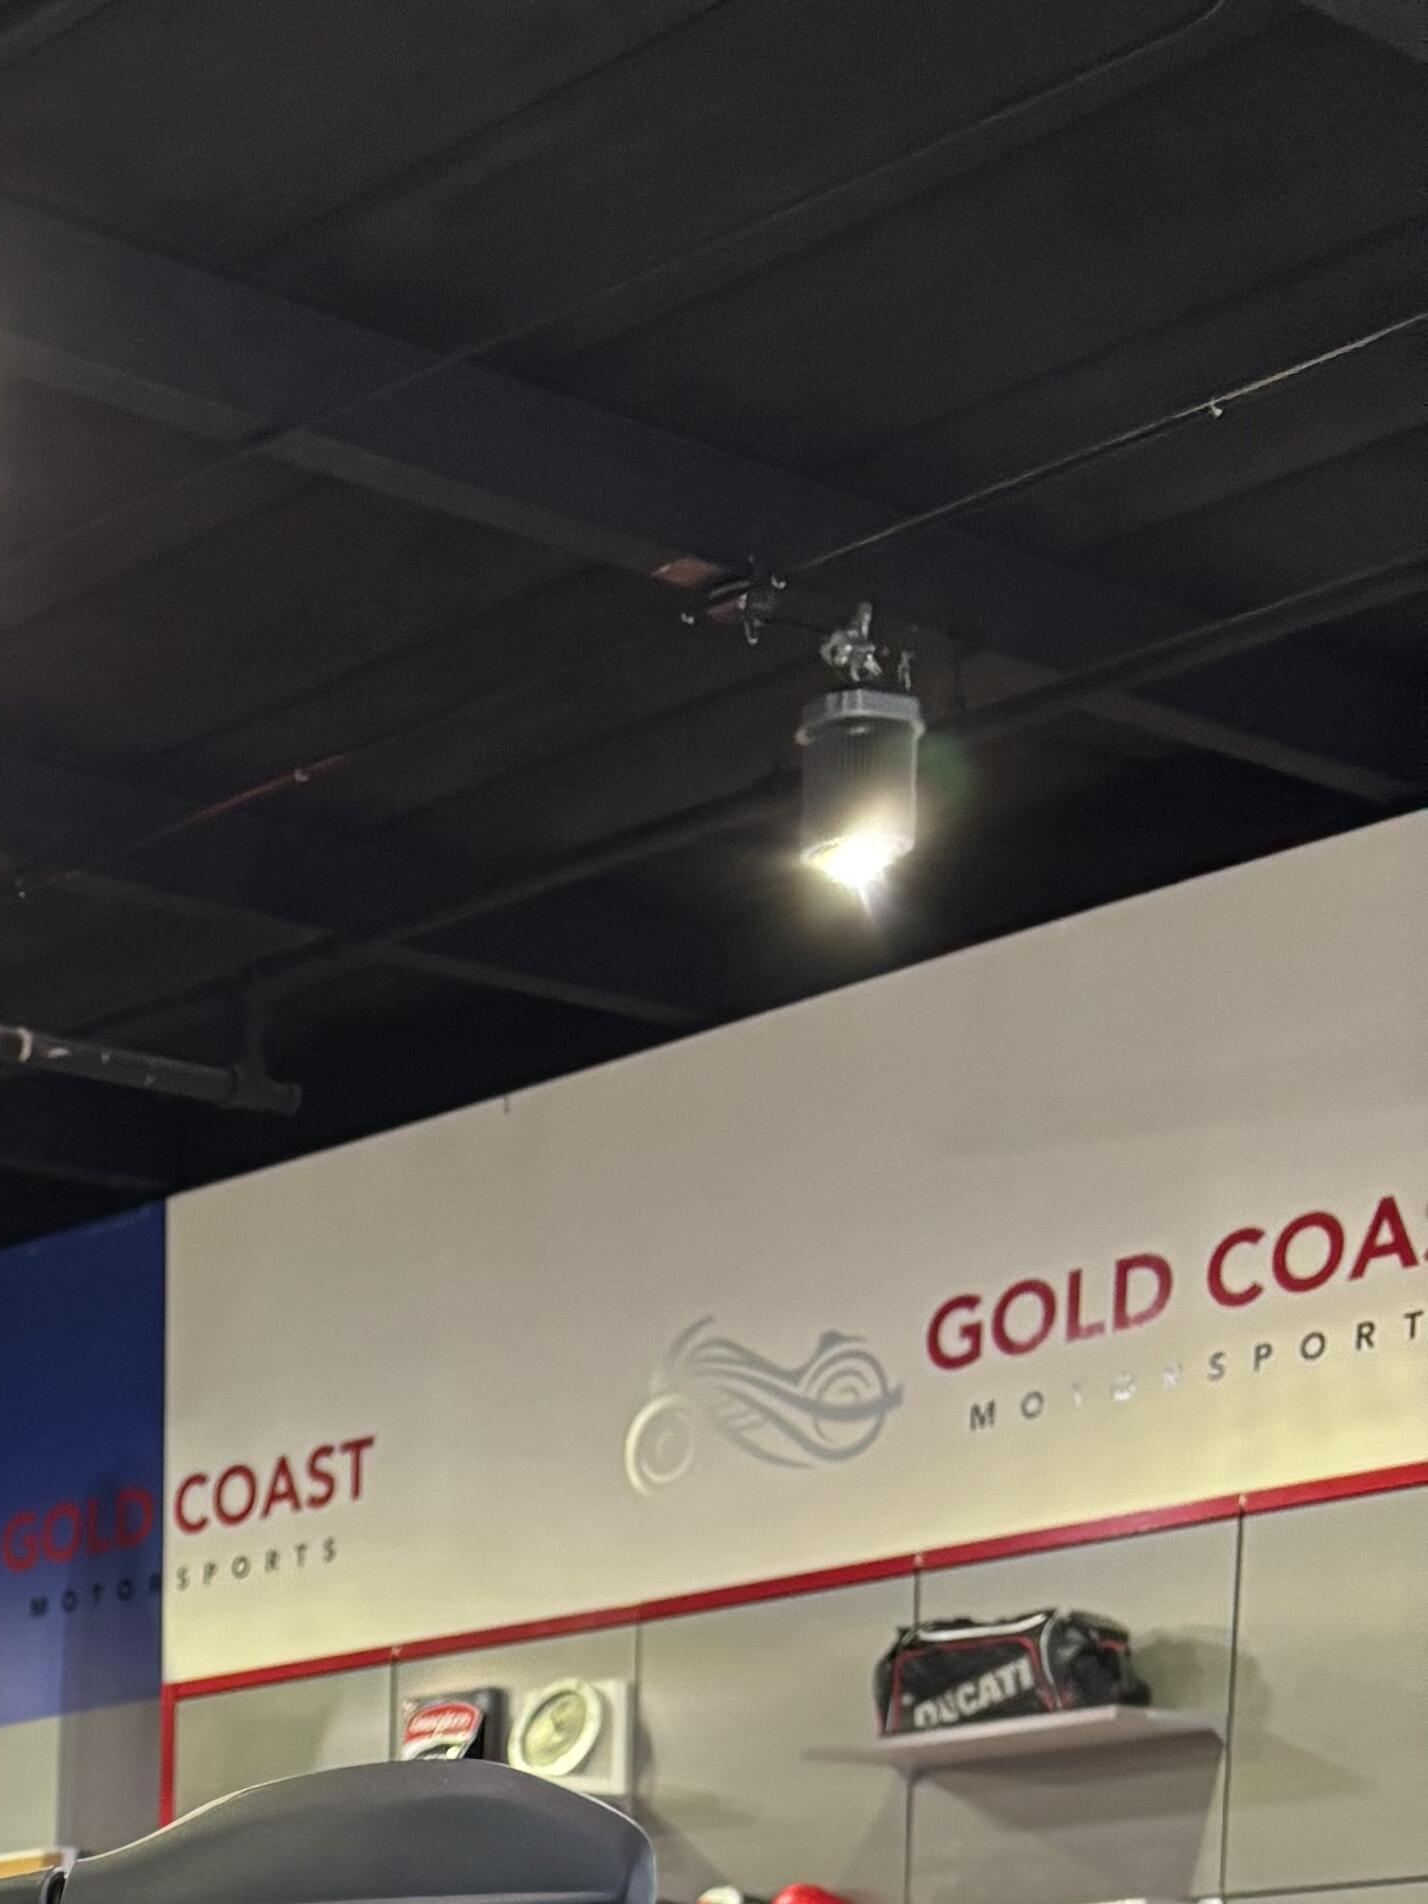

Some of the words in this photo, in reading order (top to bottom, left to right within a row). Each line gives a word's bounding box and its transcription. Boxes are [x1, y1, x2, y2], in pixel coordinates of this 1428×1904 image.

[926, 1252, 1173, 1370] GOLD
[1207, 1194, 1428, 1308] COA
[1, 1487, 155, 1573] GOLD
[174, 1435, 376, 1536] COAST
[913, 1655, 1036, 1729] DUCATI
